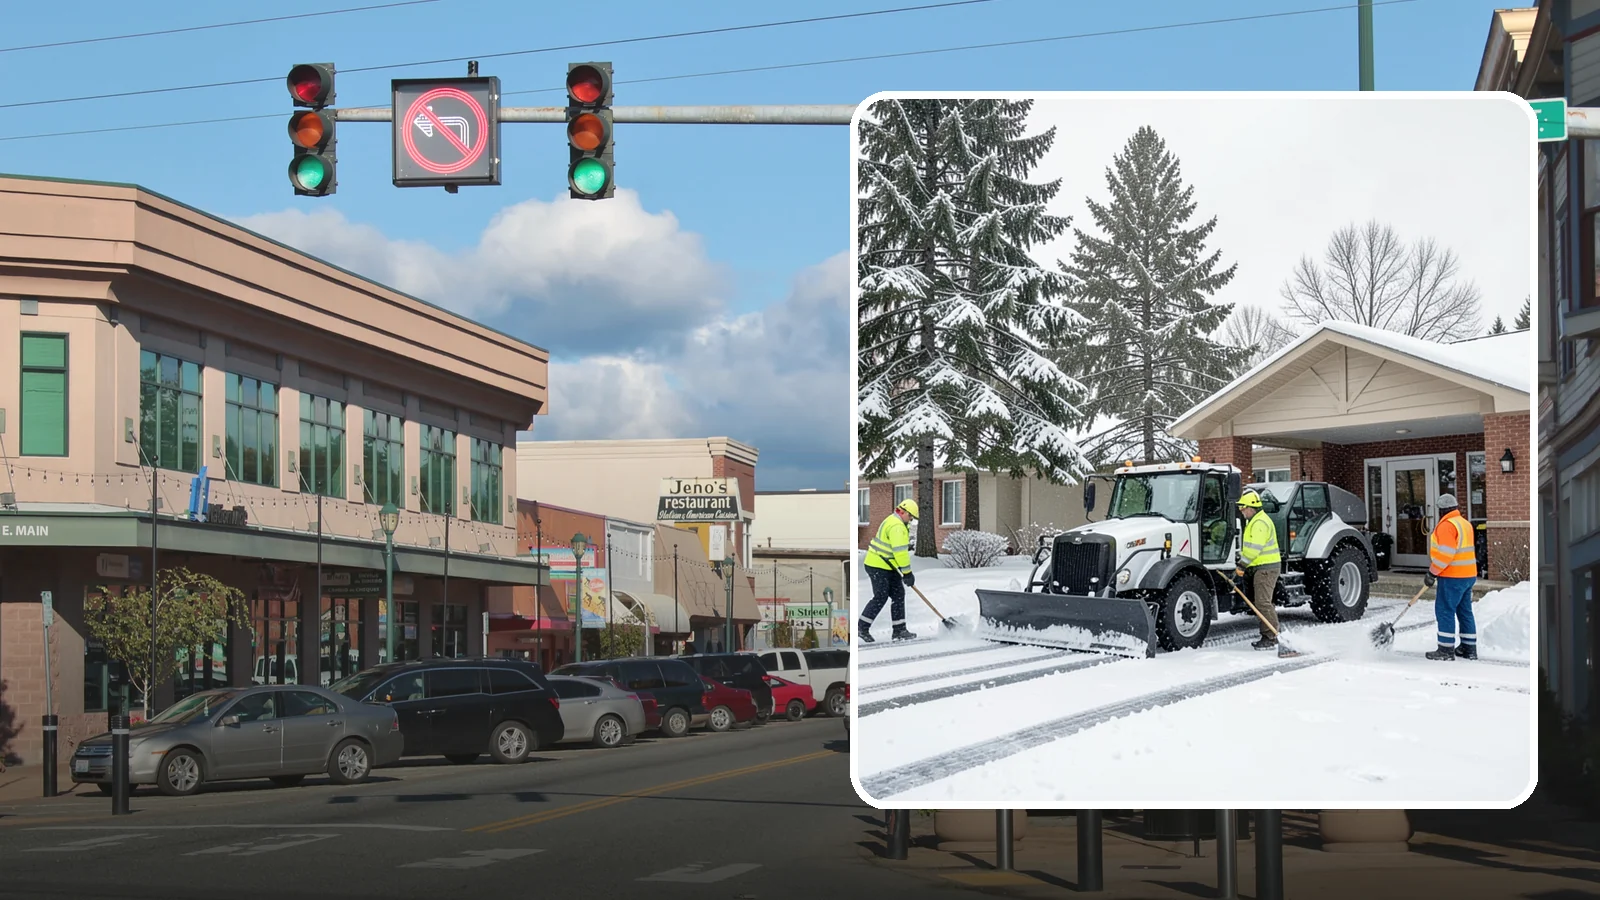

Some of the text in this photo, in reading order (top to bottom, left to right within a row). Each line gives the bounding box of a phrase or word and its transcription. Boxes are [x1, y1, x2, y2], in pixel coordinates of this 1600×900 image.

[670, 480, 727, 495] Jeno's
[665, 496, 731, 509] restaurant
[658, 510, 681, 519] Italian
[686, 510, 714, 519] American
[714, 510, 737, 519] Cuisine
[2, 525, 49, 536] E. MAIN
[797, 607, 828, 617] Street
